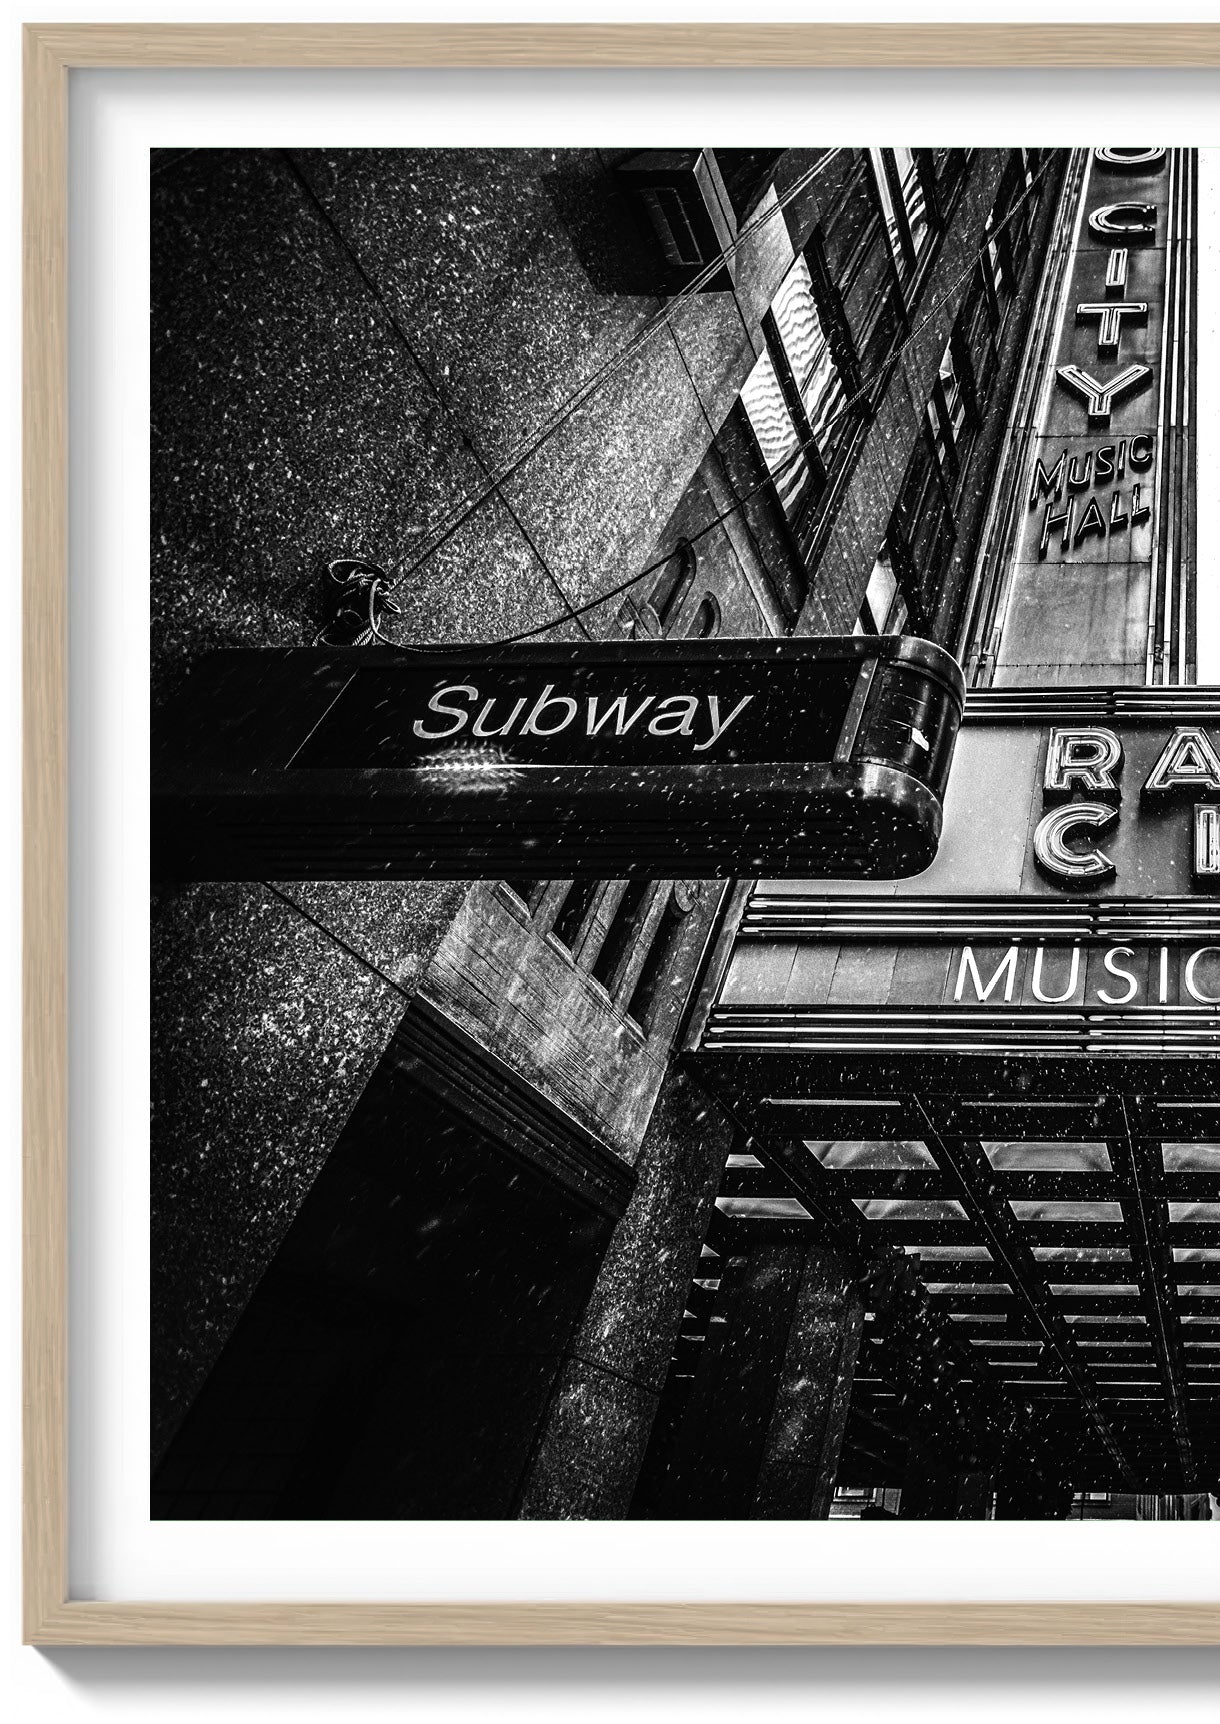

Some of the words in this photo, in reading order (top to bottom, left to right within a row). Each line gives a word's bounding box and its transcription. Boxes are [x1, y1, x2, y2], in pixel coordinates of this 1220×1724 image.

[1056, 202, 1157, 424] CITY
[1030, 434, 1153, 508] MUSIC
[1039, 484, 1151, 557] HALL
[413, 684, 754, 750] Subway
